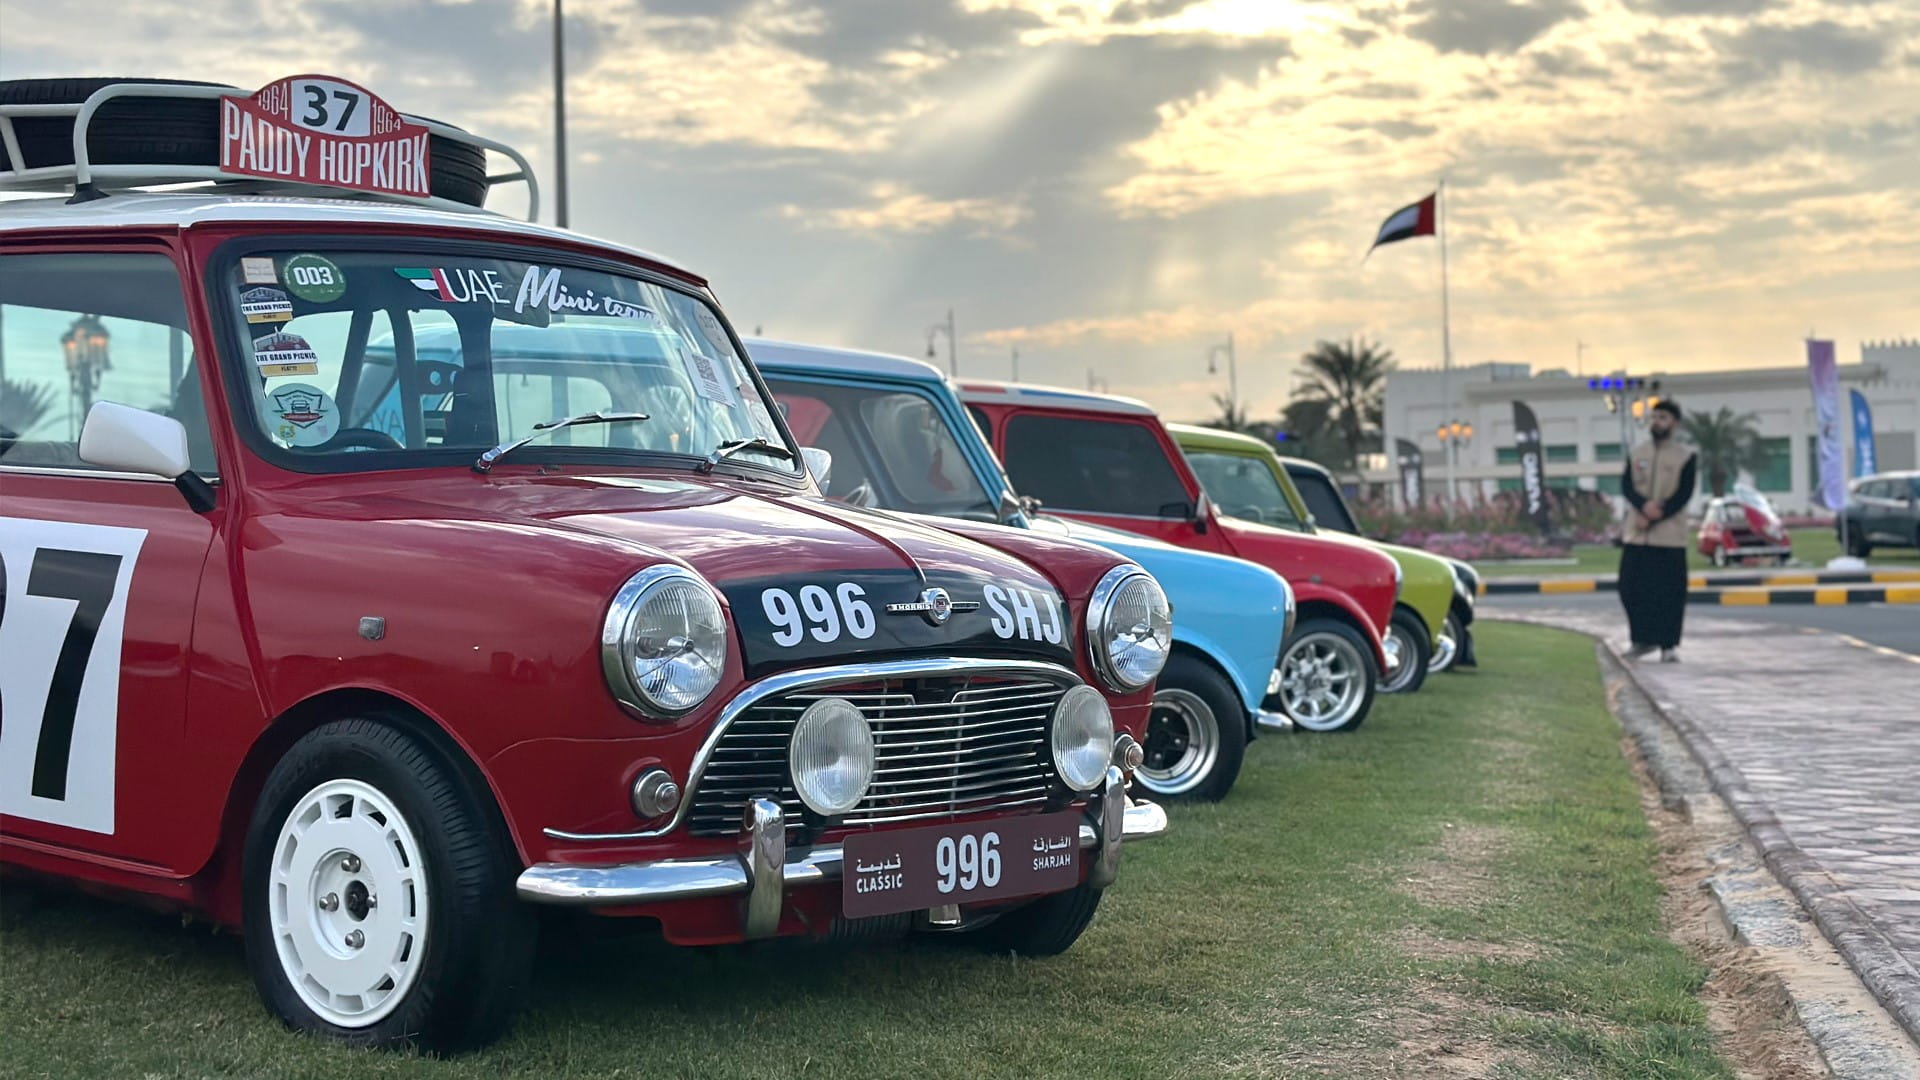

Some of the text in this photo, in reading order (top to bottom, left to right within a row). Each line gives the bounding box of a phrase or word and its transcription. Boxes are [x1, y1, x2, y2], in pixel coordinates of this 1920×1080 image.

[258, 82, 289, 121] 1964
[302, 85, 359, 131] 37
[372, 100, 401, 136] 1964
[223, 98, 429, 195] PADDY HOPKIRK
[293, 266, 334, 286] 003
[438, 268, 510, 305] UAE
[514, 265, 600, 314] Mini
[256, 352, 317, 362] THE GRAND PICNIC
[761, 582, 1062, 647] 996 SHJ
[897, 602, 932, 611] MORRIS
[0, 546, 124, 802] 7
[936, 831, 1001, 894] 996
[1033, 836, 1071, 853] الشارقة
[1033, 853, 1071, 871] SHARJAH
[856, 873, 903, 894] CLASSIC
